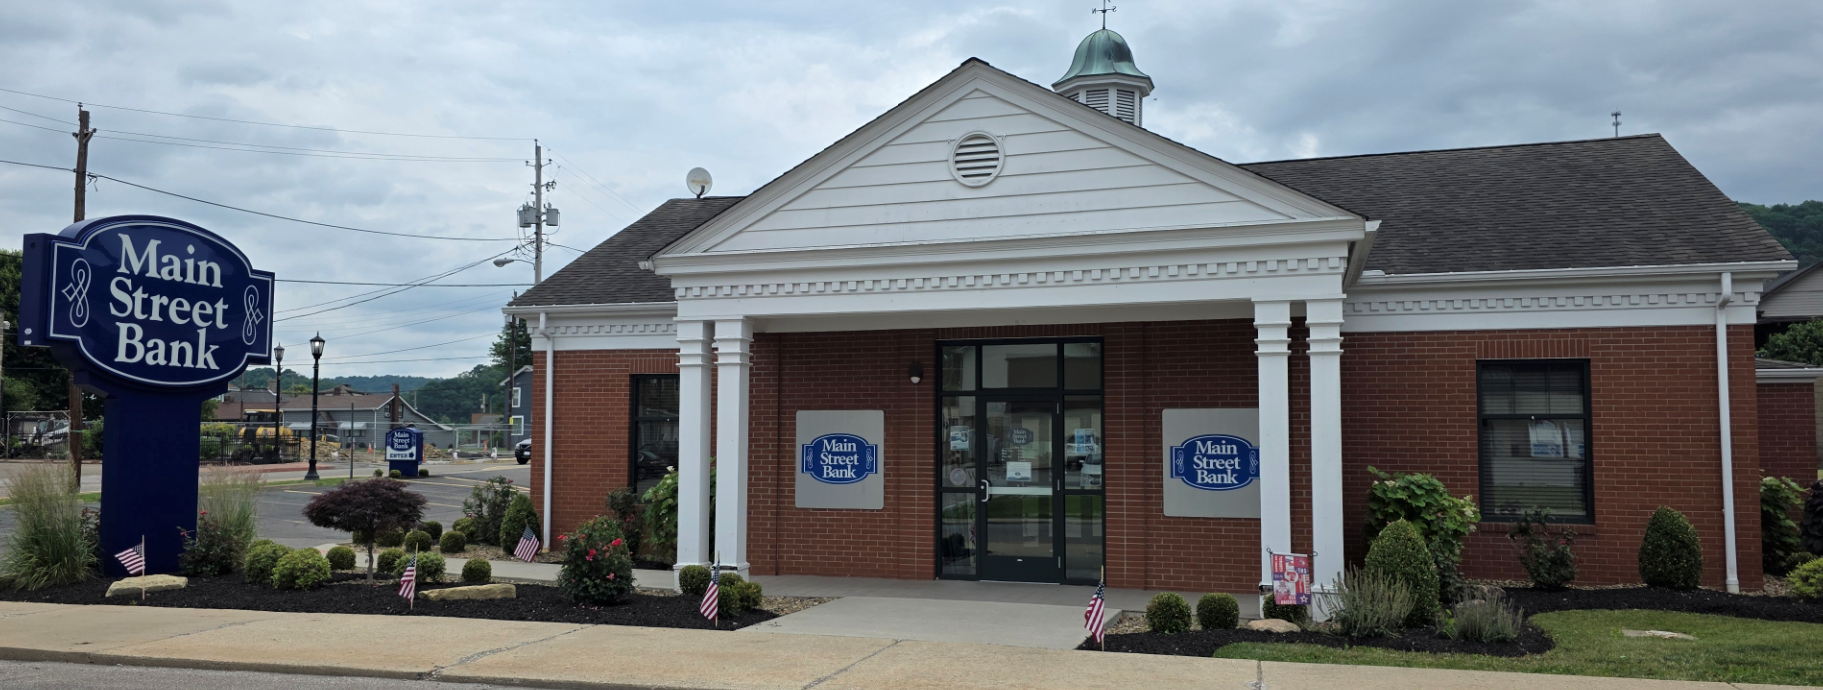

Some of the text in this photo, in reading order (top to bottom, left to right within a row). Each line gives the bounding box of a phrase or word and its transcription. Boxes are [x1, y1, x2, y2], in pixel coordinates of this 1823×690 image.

[117, 233, 223, 288] Main
[110, 277, 229, 329] Street
[114, 321, 220, 370] Bank
[822, 439, 857, 452] Main
[1194, 440, 1238, 455] Main
[820, 452, 859, 465] Street
[1194, 455, 1240, 469] Street
[822, 465, 857, 478] Bank
[1195, 469, 1239, 484] Bank
